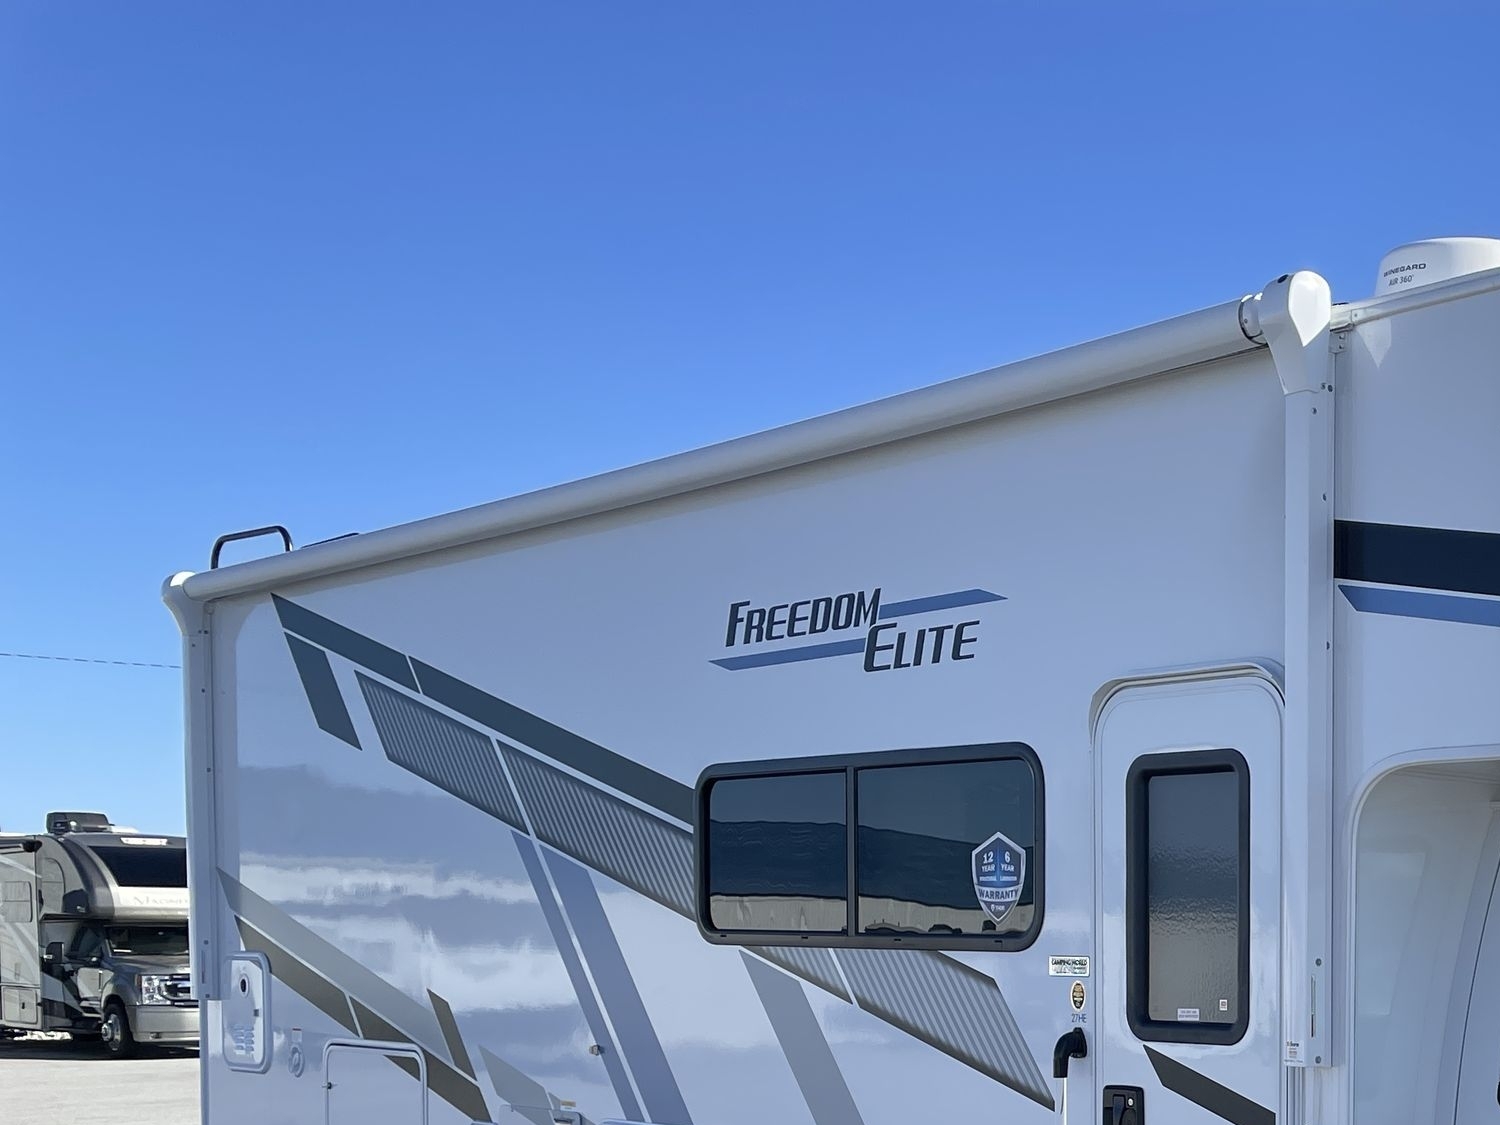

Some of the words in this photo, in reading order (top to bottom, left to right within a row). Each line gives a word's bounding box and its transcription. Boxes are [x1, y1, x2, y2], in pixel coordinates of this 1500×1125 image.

[1383, 263, 1427, 278] WINEGARD
[725, 587, 882, 647] FREEDOM
[863, 620, 980, 672] ELITE
[983, 851, 994, 864] 12
[1004, 851, 1011, 863] 6
[981, 864, 996, 872] YEAR
[1001, 863, 1015, 872] YEAR
[979, 889, 1019, 900] WARRANTY
